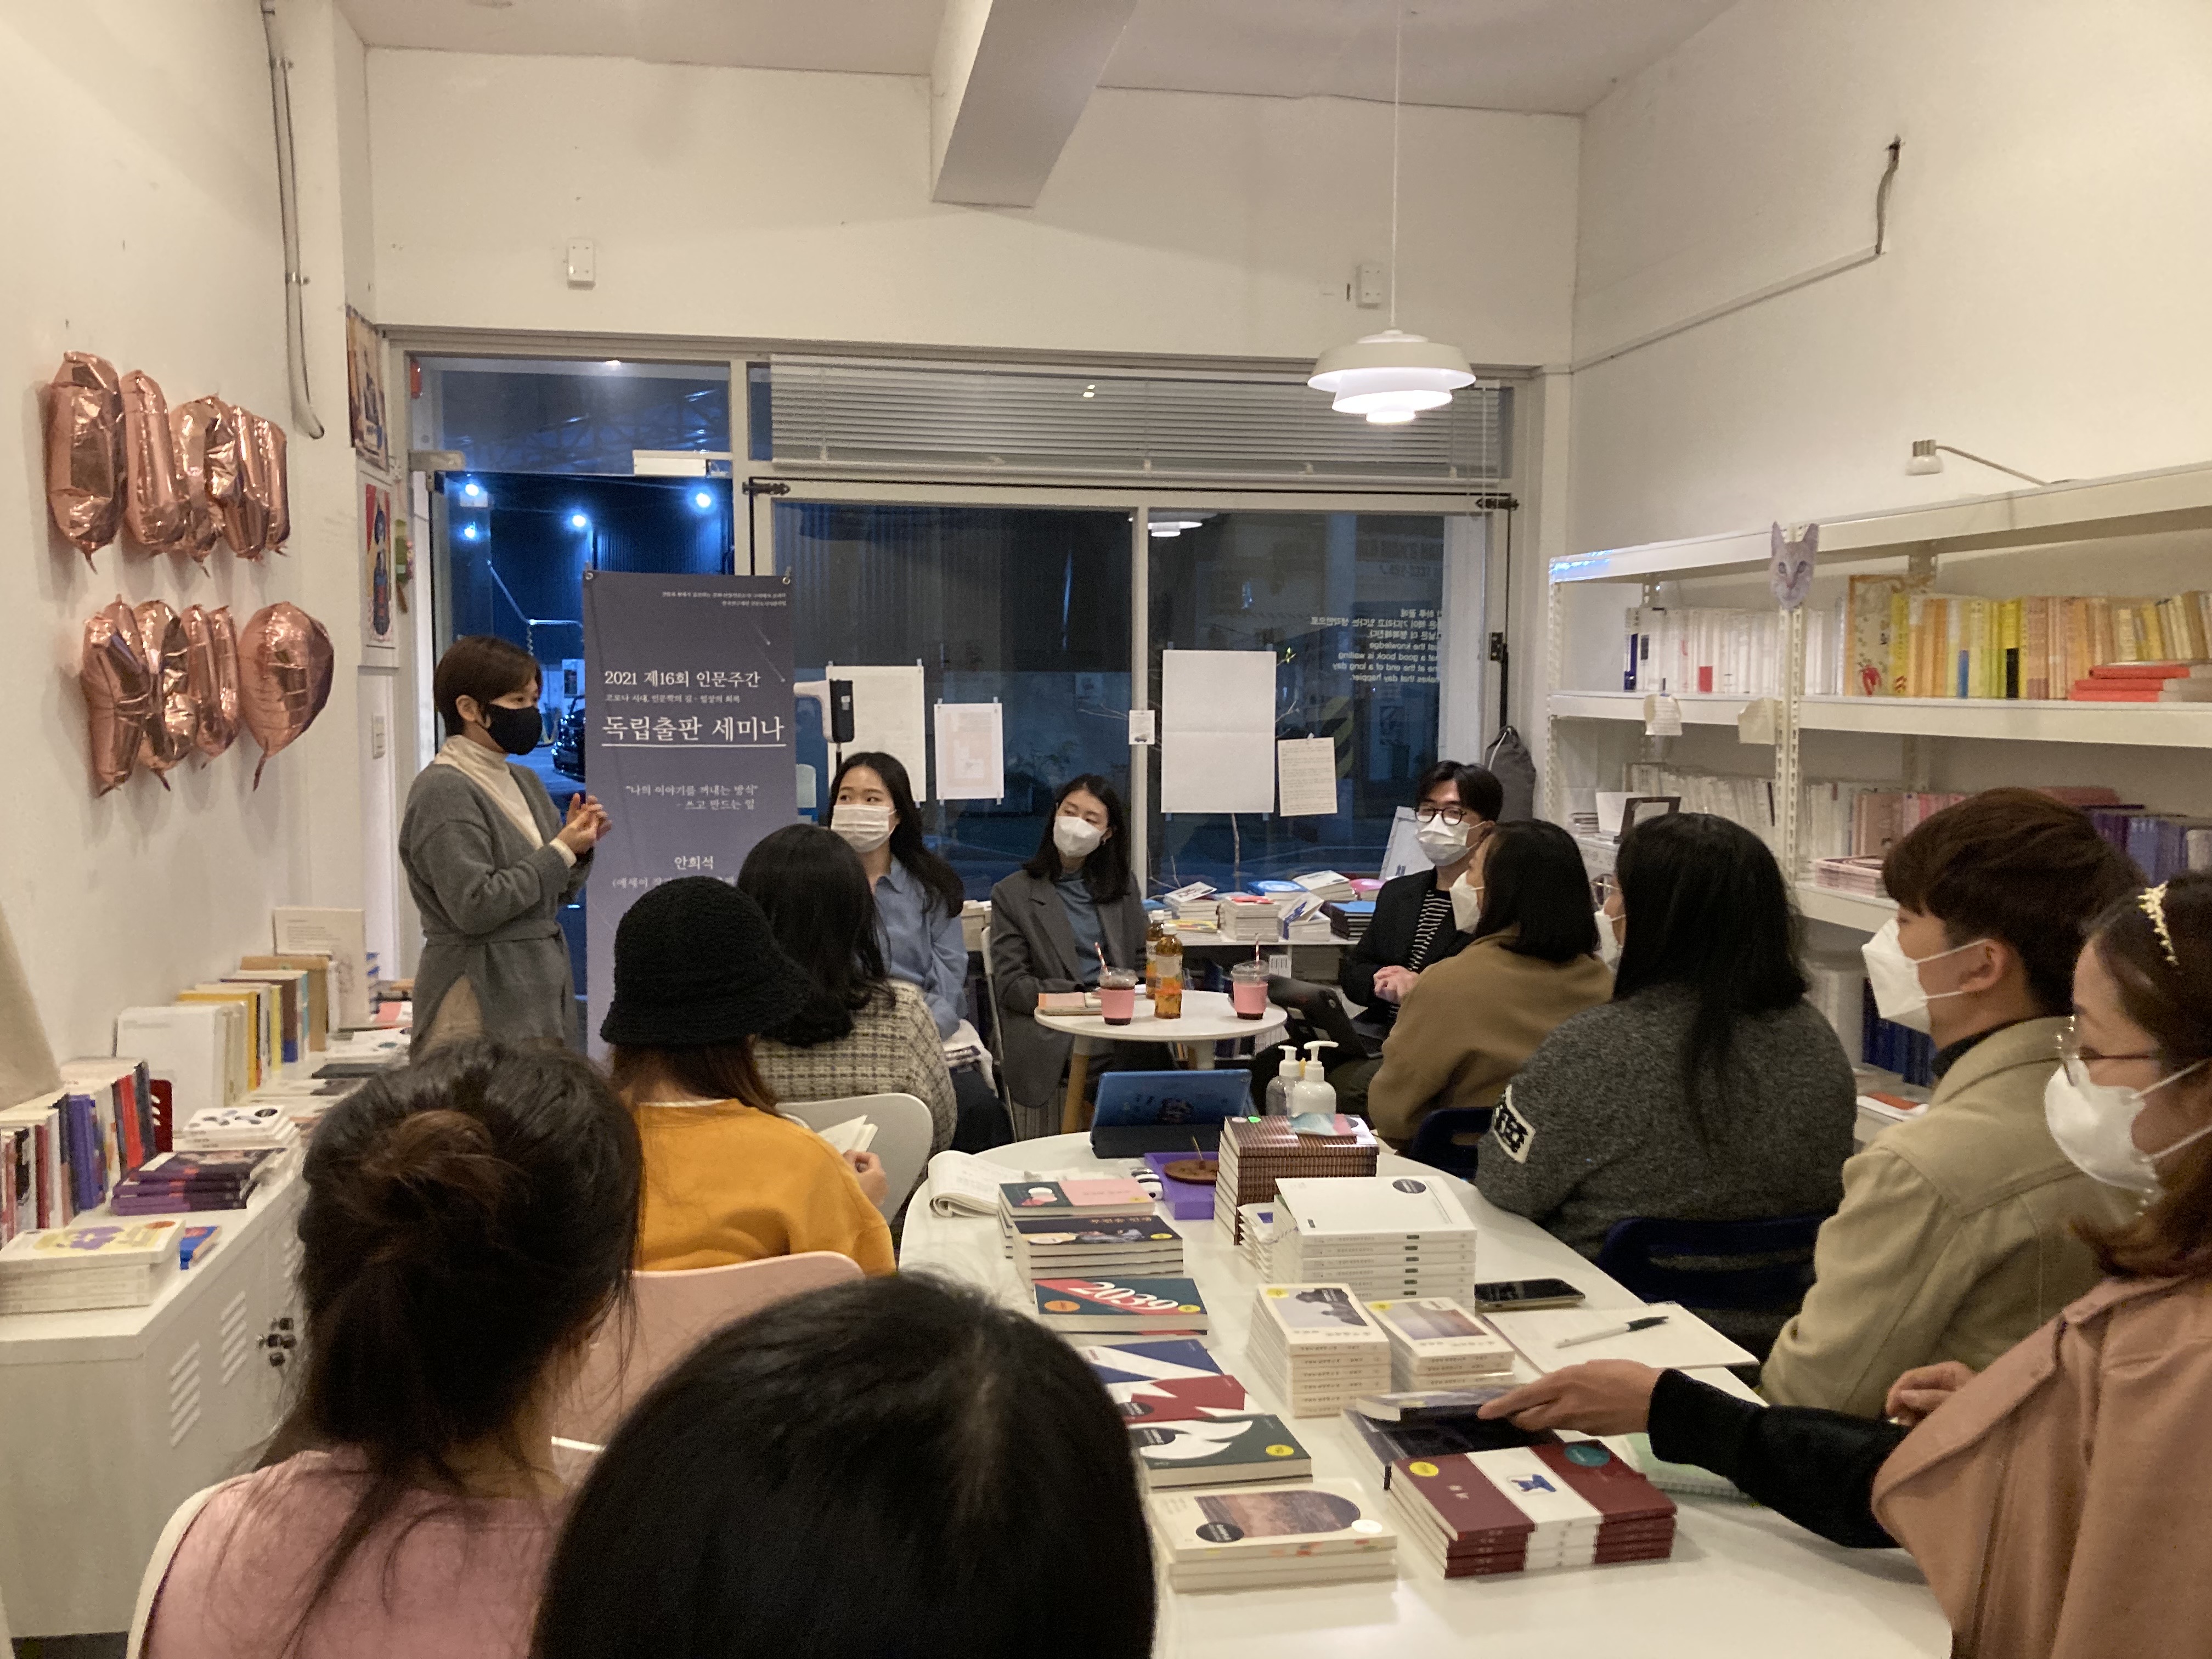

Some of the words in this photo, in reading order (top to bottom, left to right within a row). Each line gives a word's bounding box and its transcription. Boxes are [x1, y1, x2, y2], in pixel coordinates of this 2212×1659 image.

[605, 671, 637, 686] 2021
[644, 670, 689, 687] 제16회
[696, 671, 761, 689] 인문주간
[602, 715, 703, 741] 독립출판
[712, 716, 785, 742] 세미나
[654, 784, 696, 796] 이야기를
[684, 799, 707, 810] 쓰고
[709, 798, 742, 810] 만드는
